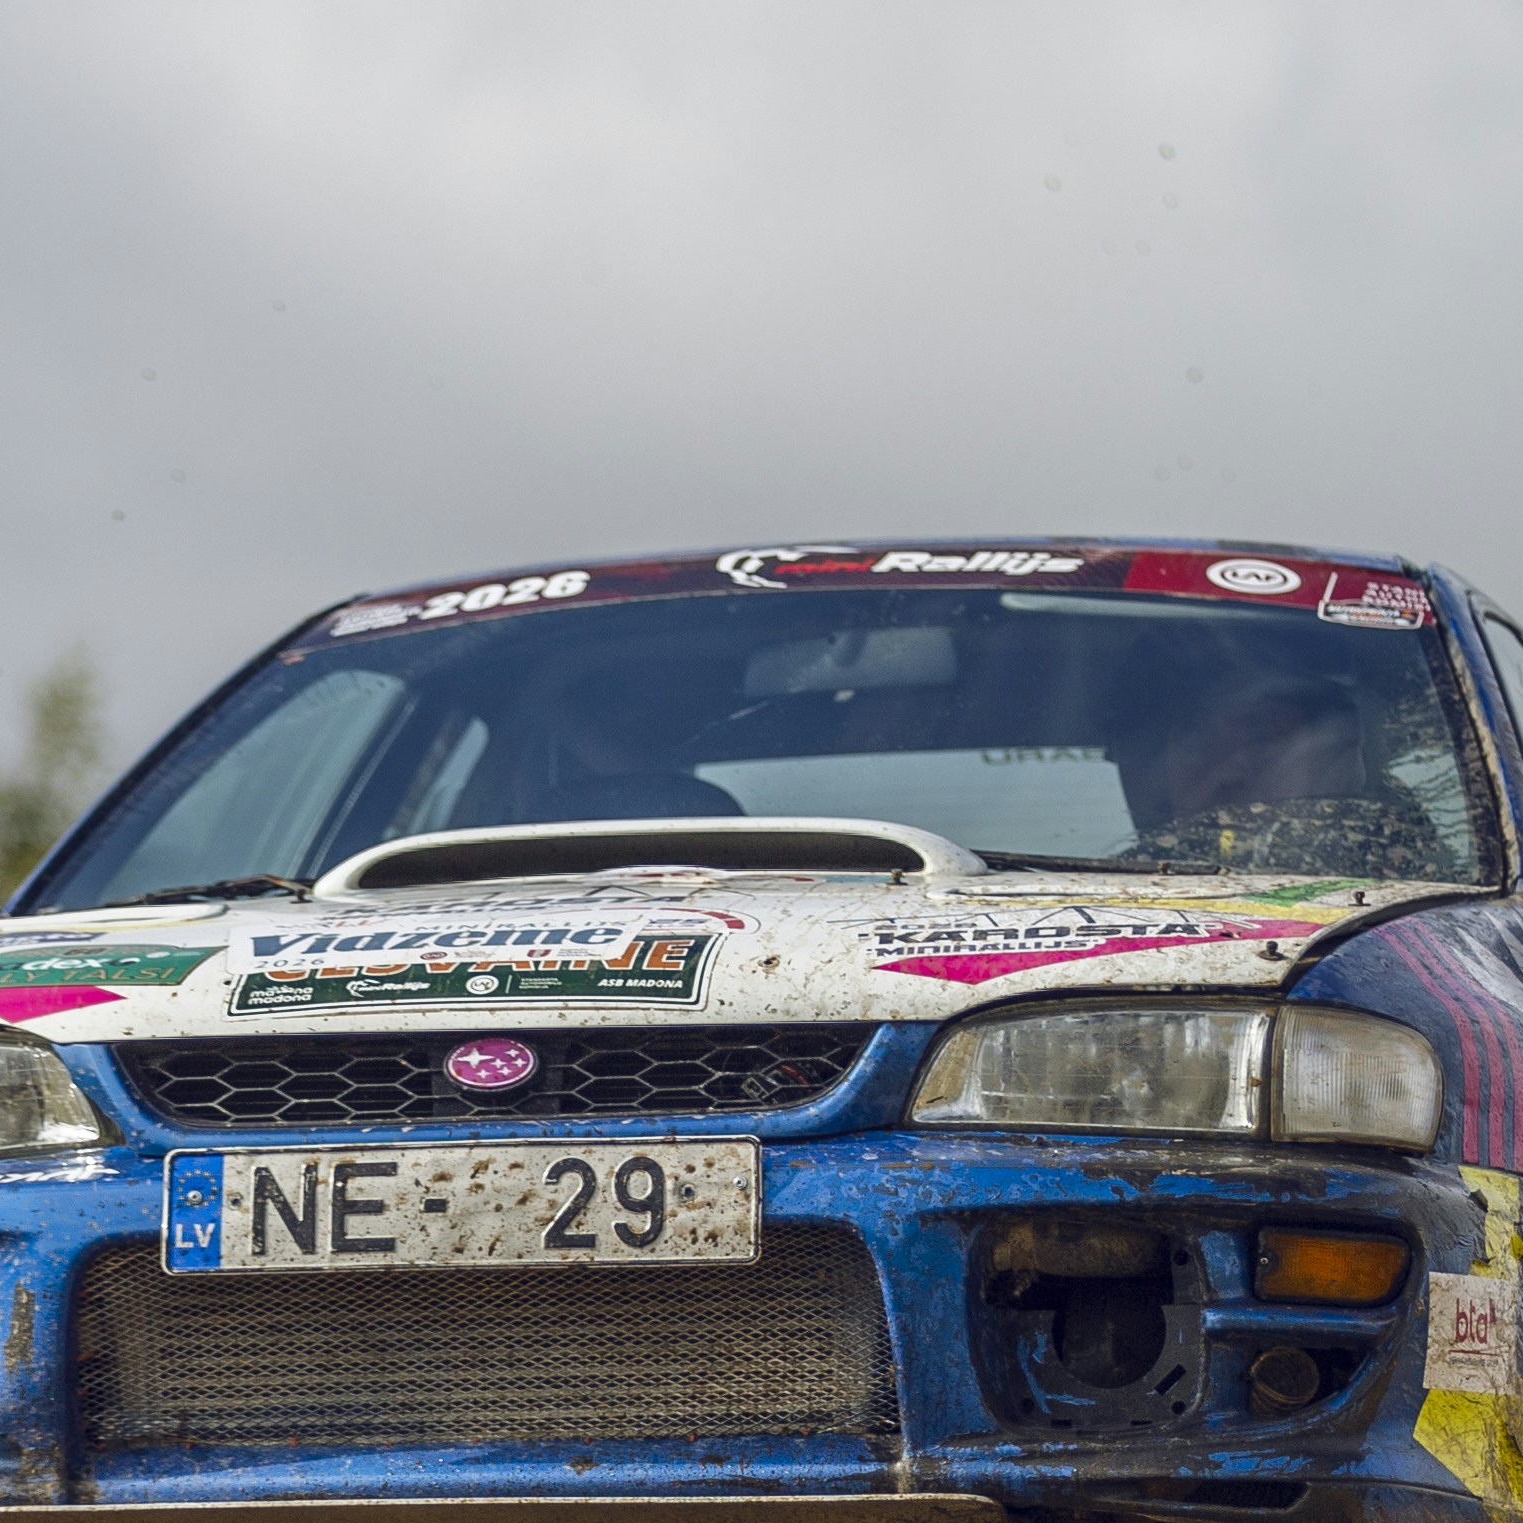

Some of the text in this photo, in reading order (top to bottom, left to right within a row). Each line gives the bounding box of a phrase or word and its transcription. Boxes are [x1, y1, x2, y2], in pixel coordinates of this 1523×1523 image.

[418, 570, 591, 620] 2026
[415, 919, 627, 931] MINIRALLIJS
[250, 927, 623, 957] Vidzeme
[255, 957, 325, 969] 2026
[63, 967, 176, 981] TALSI
[598, 978, 683, 988] ASB MADONA
[248, 994, 312, 1006] madona
[542, 1156, 666, 1250] 29
[174, 1222, 215, 1249] LV
